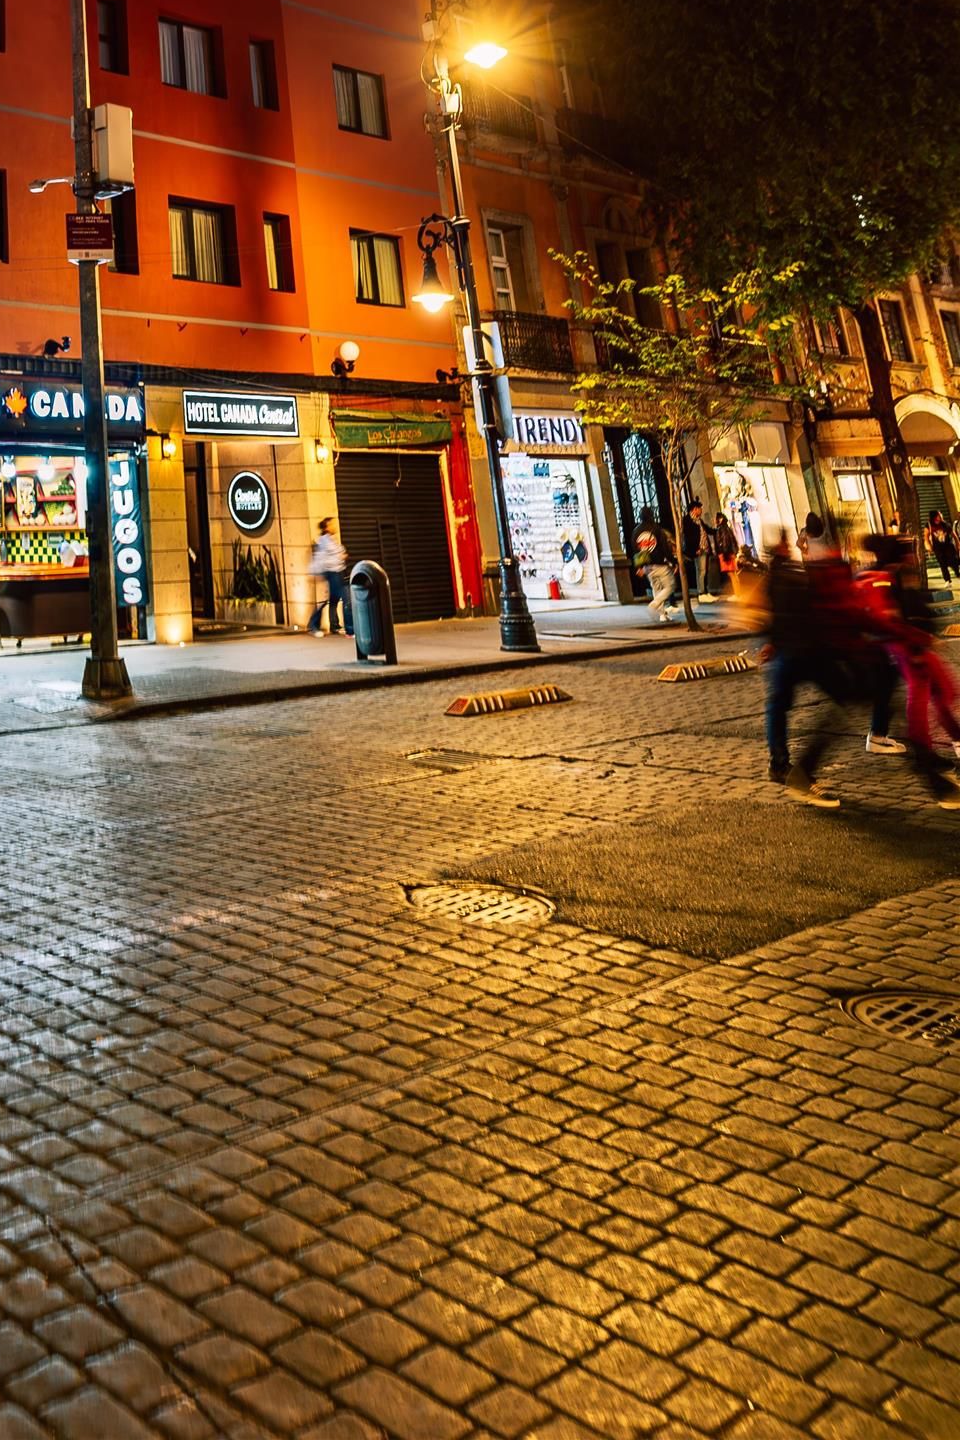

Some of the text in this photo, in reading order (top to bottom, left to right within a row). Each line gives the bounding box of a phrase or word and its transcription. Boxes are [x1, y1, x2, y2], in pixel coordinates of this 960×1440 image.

[30, 390, 142, 422] CANDA
[187, 401, 294, 425] HOTEL CANADA Central
[514, 416, 586, 443] TRENDY
[234, 487, 262, 503] Central
[111, 461, 143, 604] JUGOS
